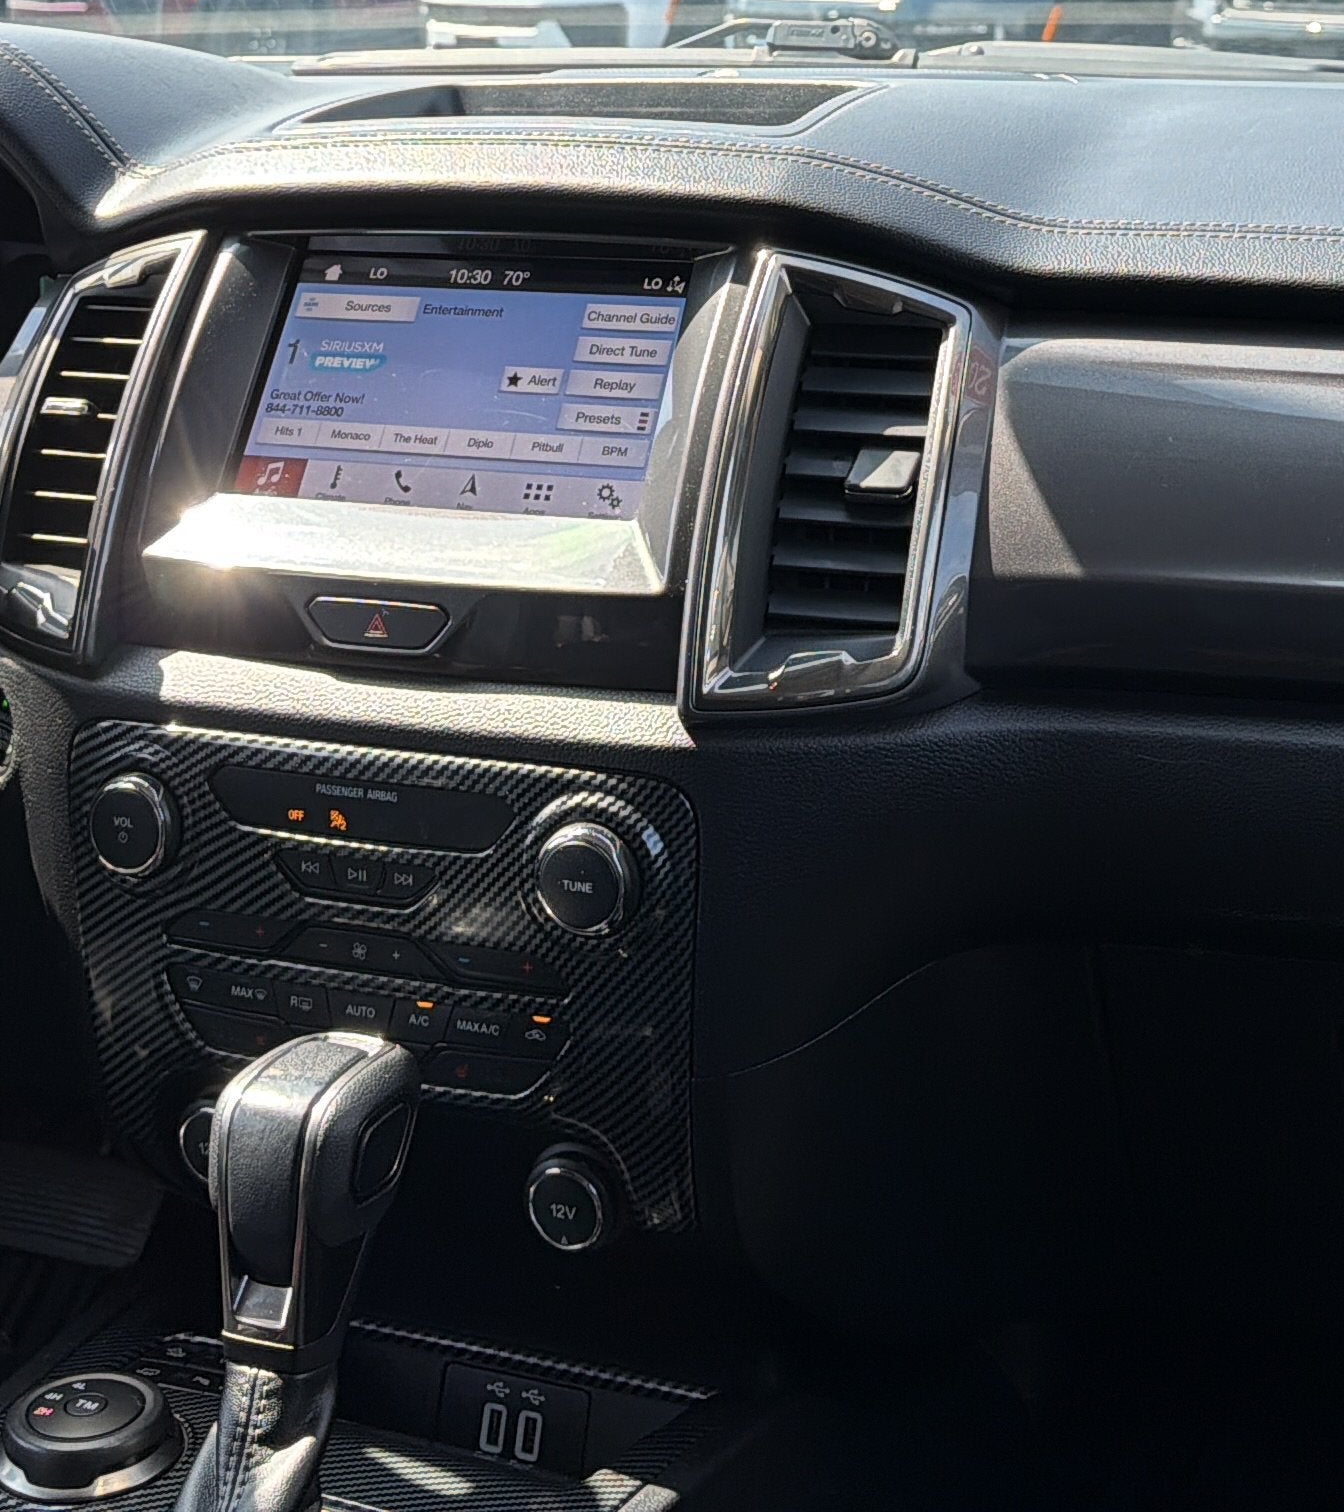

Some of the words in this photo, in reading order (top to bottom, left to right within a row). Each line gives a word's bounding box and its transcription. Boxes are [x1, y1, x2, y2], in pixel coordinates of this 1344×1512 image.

[369, 267, 388, 280] LO
[448, 268, 493, 285] 10:30
[503, 270, 531, 286] 70°
[643, 277, 663, 290] LO
[345, 300, 392, 314] Sources
[422, 303, 504, 318] Entertainment
[587, 310, 637, 324] Channel
[640, 312, 676, 326] Guide
[287, 339, 300, 365] 1
[320, 339, 384, 353] SIRIUSXM
[588, 344, 625, 358] Direct
[628, 346, 658, 359] Tune
[314, 356, 380, 370] PREVIEW
[527, 374, 558, 387] Alert
[593, 378, 636, 394] Replay
[270, 389, 302, 402] Great
[304, 390, 331, 403] Offer
[334, 392, 365, 405] Now!
[265, 403, 345, 418] 844-711-8800
[575, 411, 622, 426] Presets
[274, 425, 294, 437] Hits
[296, 427, 303, 437] 1
[330, 429, 371, 442] Monaco
[392, 433, 412, 444] The
[413, 433, 439, 446] Heat
[467, 437, 494, 451] Diplo
[531, 441, 565, 454] Pitbull
[601, 445, 629, 458] BPM
[315, 782, 364, 799] PASSENGER
[366, 788, 398, 804] AIRBAG
[113, 815, 134, 828] VOL
[287, 809, 305, 821] OFF
[561, 879, 594, 894] TUNE
[230, 985, 254, 999] MAX
[289, 995, 299, 1008] R
[345, 1003, 376, 1019] AUTO
[408, 1013, 430, 1027] A/C
[550, 1202, 577, 1221] 12V
[44, 1392, 64, 1401] 4H
[33, 1406, 55, 1417] 2H
[75, 1398, 99, 1411] TM
